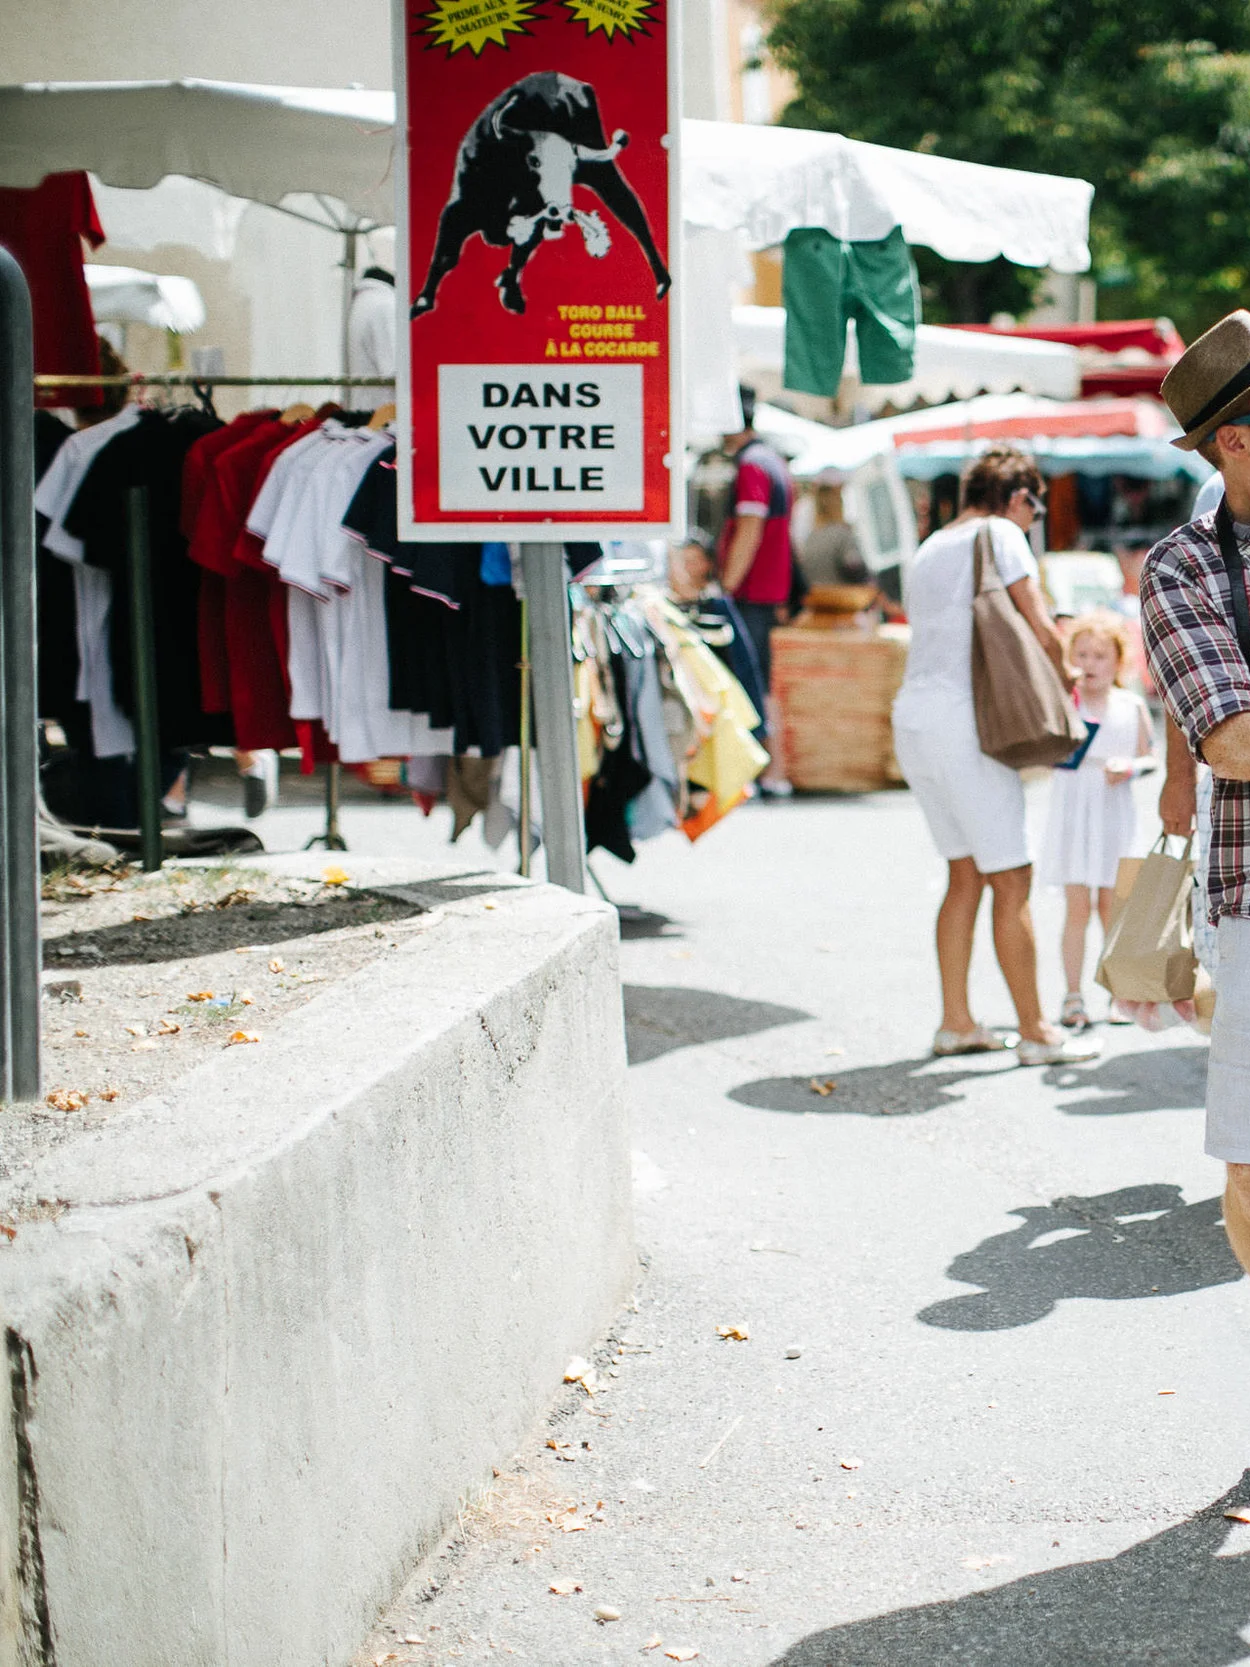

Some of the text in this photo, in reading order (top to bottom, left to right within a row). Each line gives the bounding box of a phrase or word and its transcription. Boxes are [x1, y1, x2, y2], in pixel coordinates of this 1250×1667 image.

[454, 10, 511, 35] AMATEURS
[557, 305, 646, 321] TORO BALL
[569, 323, 636, 339] COURSE
[560, 341, 582, 357] LA
[583, 341, 659, 357] COCARDE
[482, 382, 601, 409] DANS
[467, 424, 615, 450] VOTRE
[479, 466, 604, 492] VILLE
